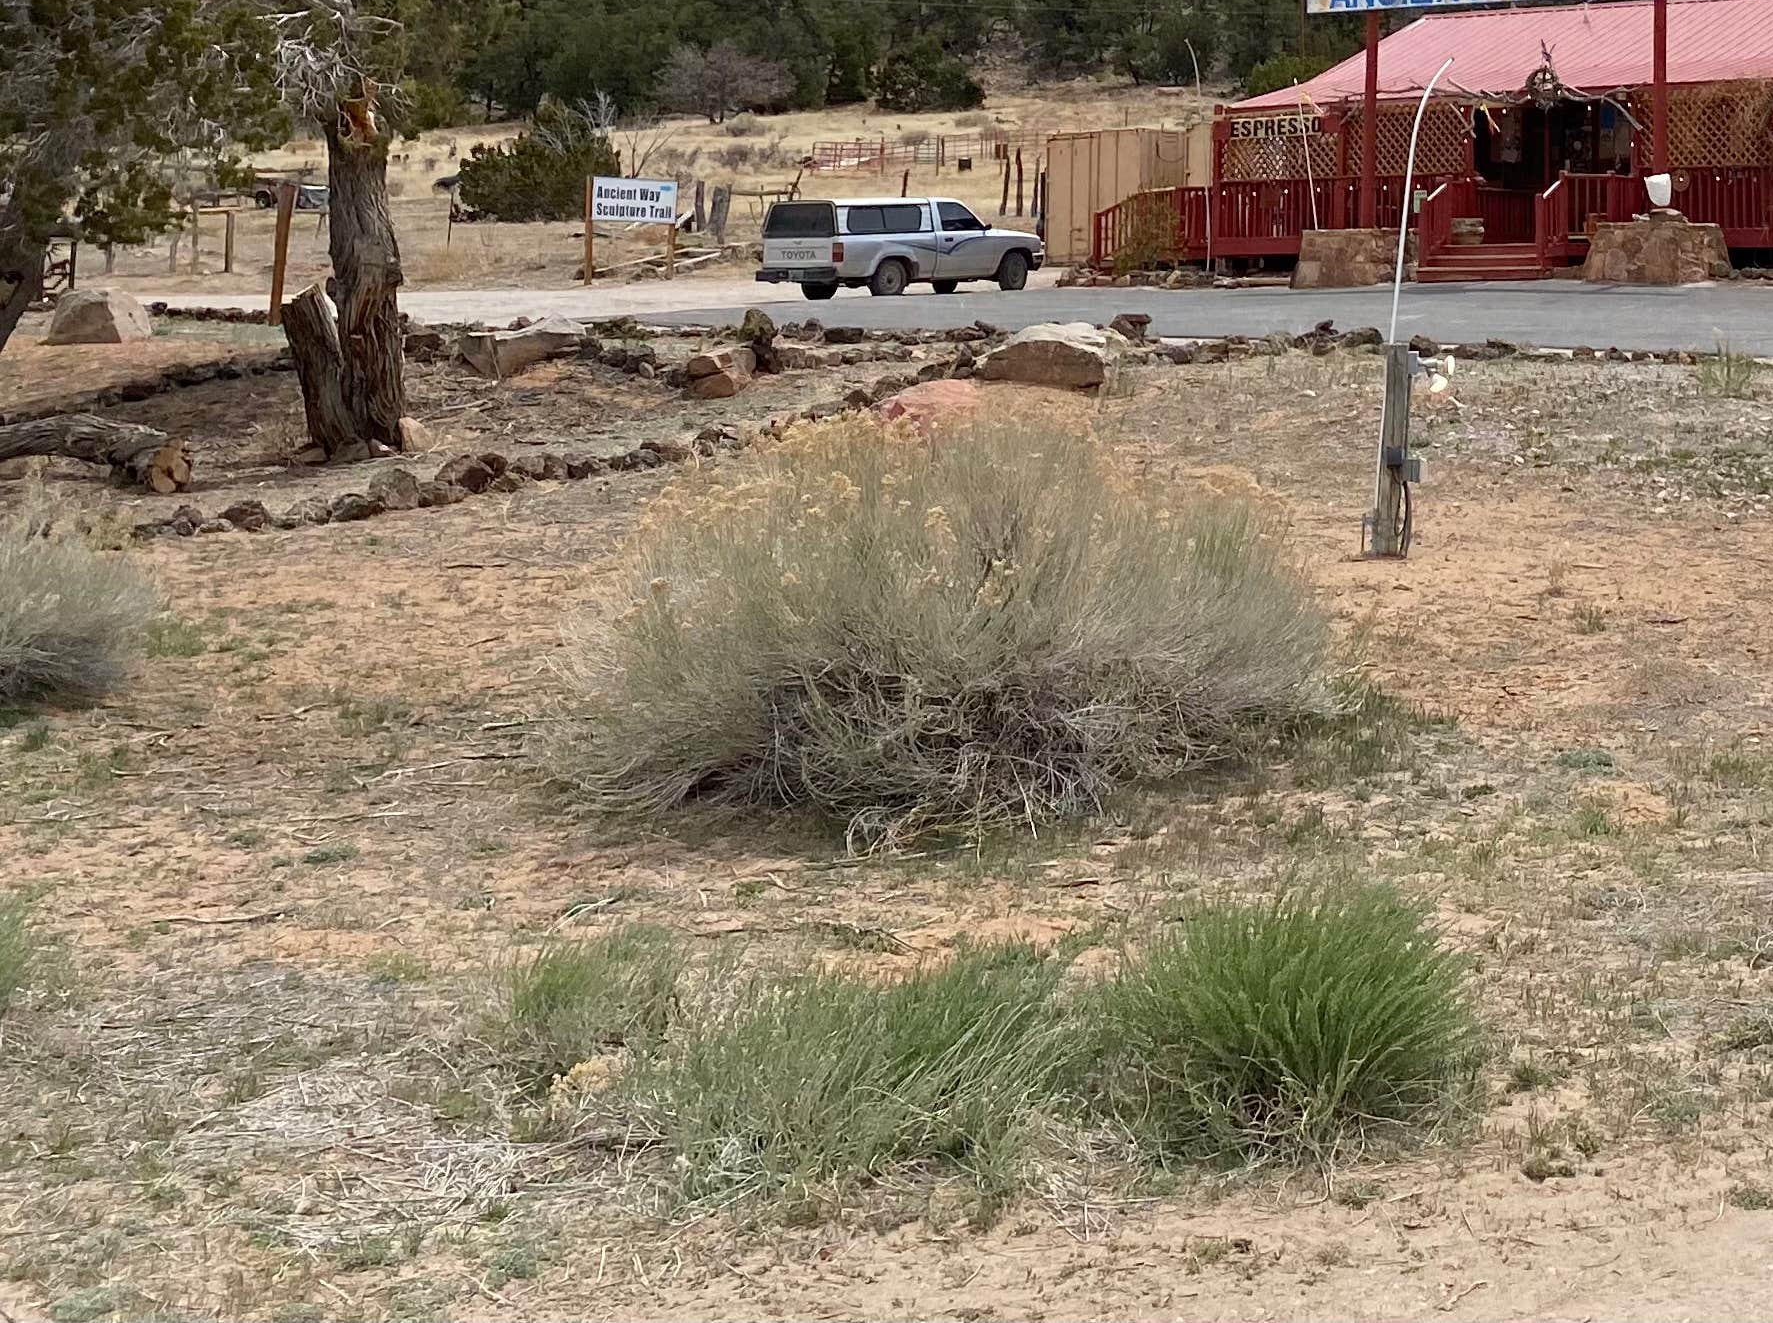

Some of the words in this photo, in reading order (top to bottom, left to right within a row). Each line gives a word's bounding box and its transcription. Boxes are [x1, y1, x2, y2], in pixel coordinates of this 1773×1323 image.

[1230, 117, 1321, 138] ESPRESSO
[597, 186, 637, 200] Ancient
[640, 188, 661, 202] Way
[596, 203, 647, 218] Sculpture
[650, 206, 672, 218] Trail
[781, 250, 817, 259] TOYOTA
